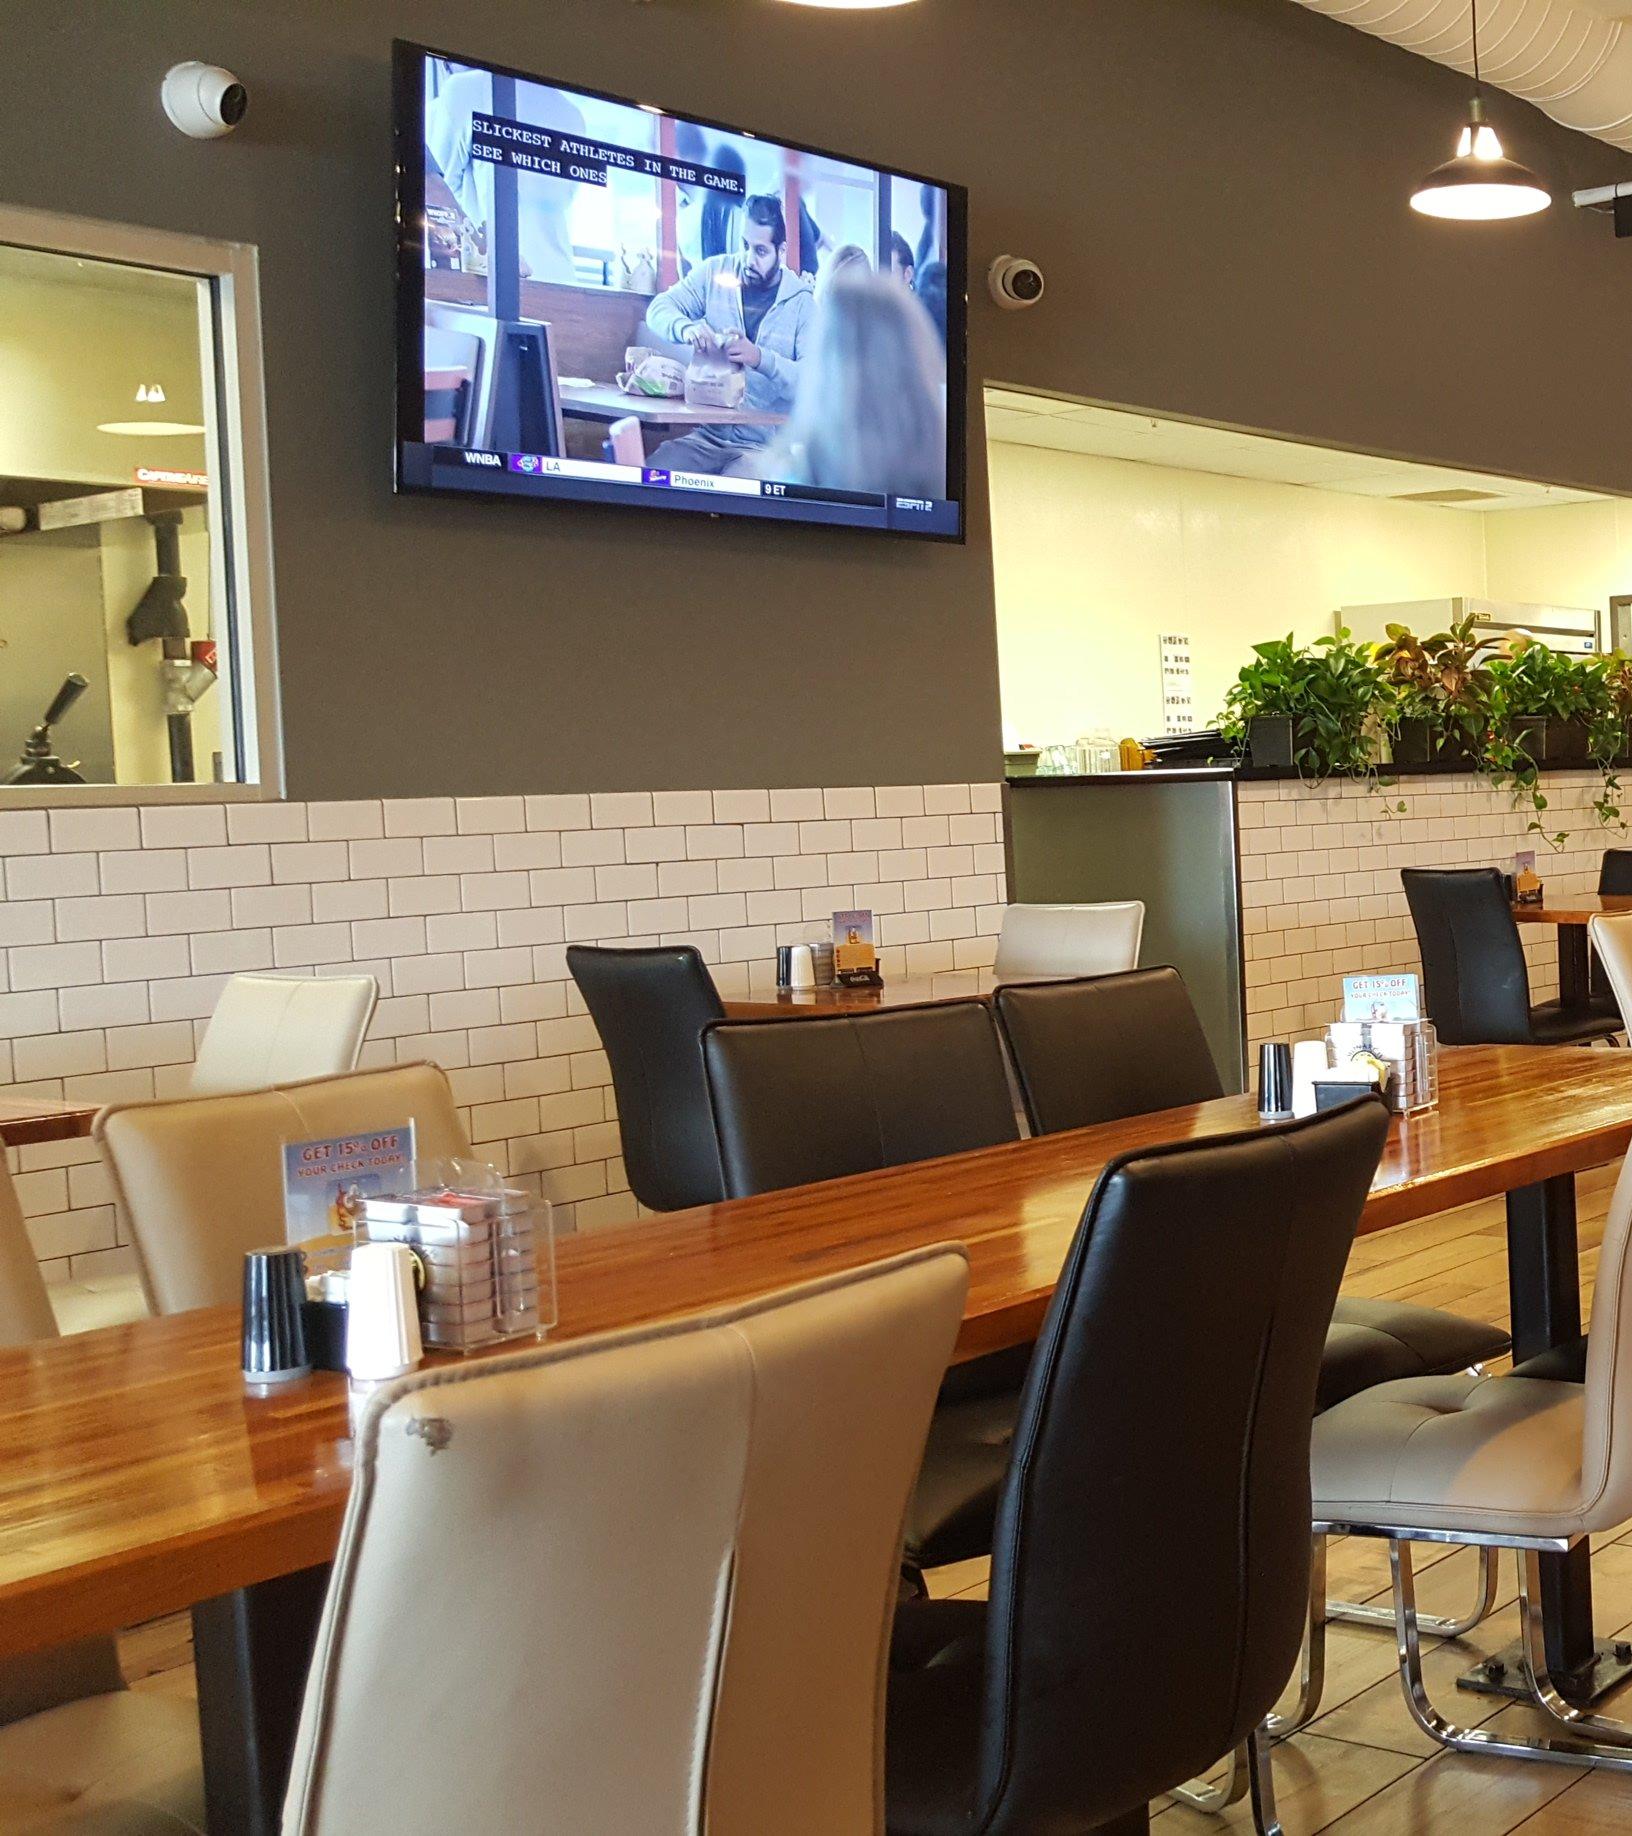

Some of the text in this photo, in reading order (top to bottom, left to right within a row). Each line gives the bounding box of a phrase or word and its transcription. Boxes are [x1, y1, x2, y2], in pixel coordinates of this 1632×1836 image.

[472, 120, 744, 193] SLICKEST ATHLETES IN THE GAME.
[472, 143, 607, 184] SEE WHICH ONES
[465, 452, 501, 466] WNBA
[546, 460, 561, 472] LA
[674, 474, 715, 488] Phoenix
[765, 484, 786, 496] 9 ET
[1353, 981, 1368, 989] GET
[1390, 978, 1406, 987] OFF
[302, 1135, 398, 1161] GET 15% OFF
[298, 1165, 327, 1178] YOUR
[331, 1160, 364, 1173] CHECK
